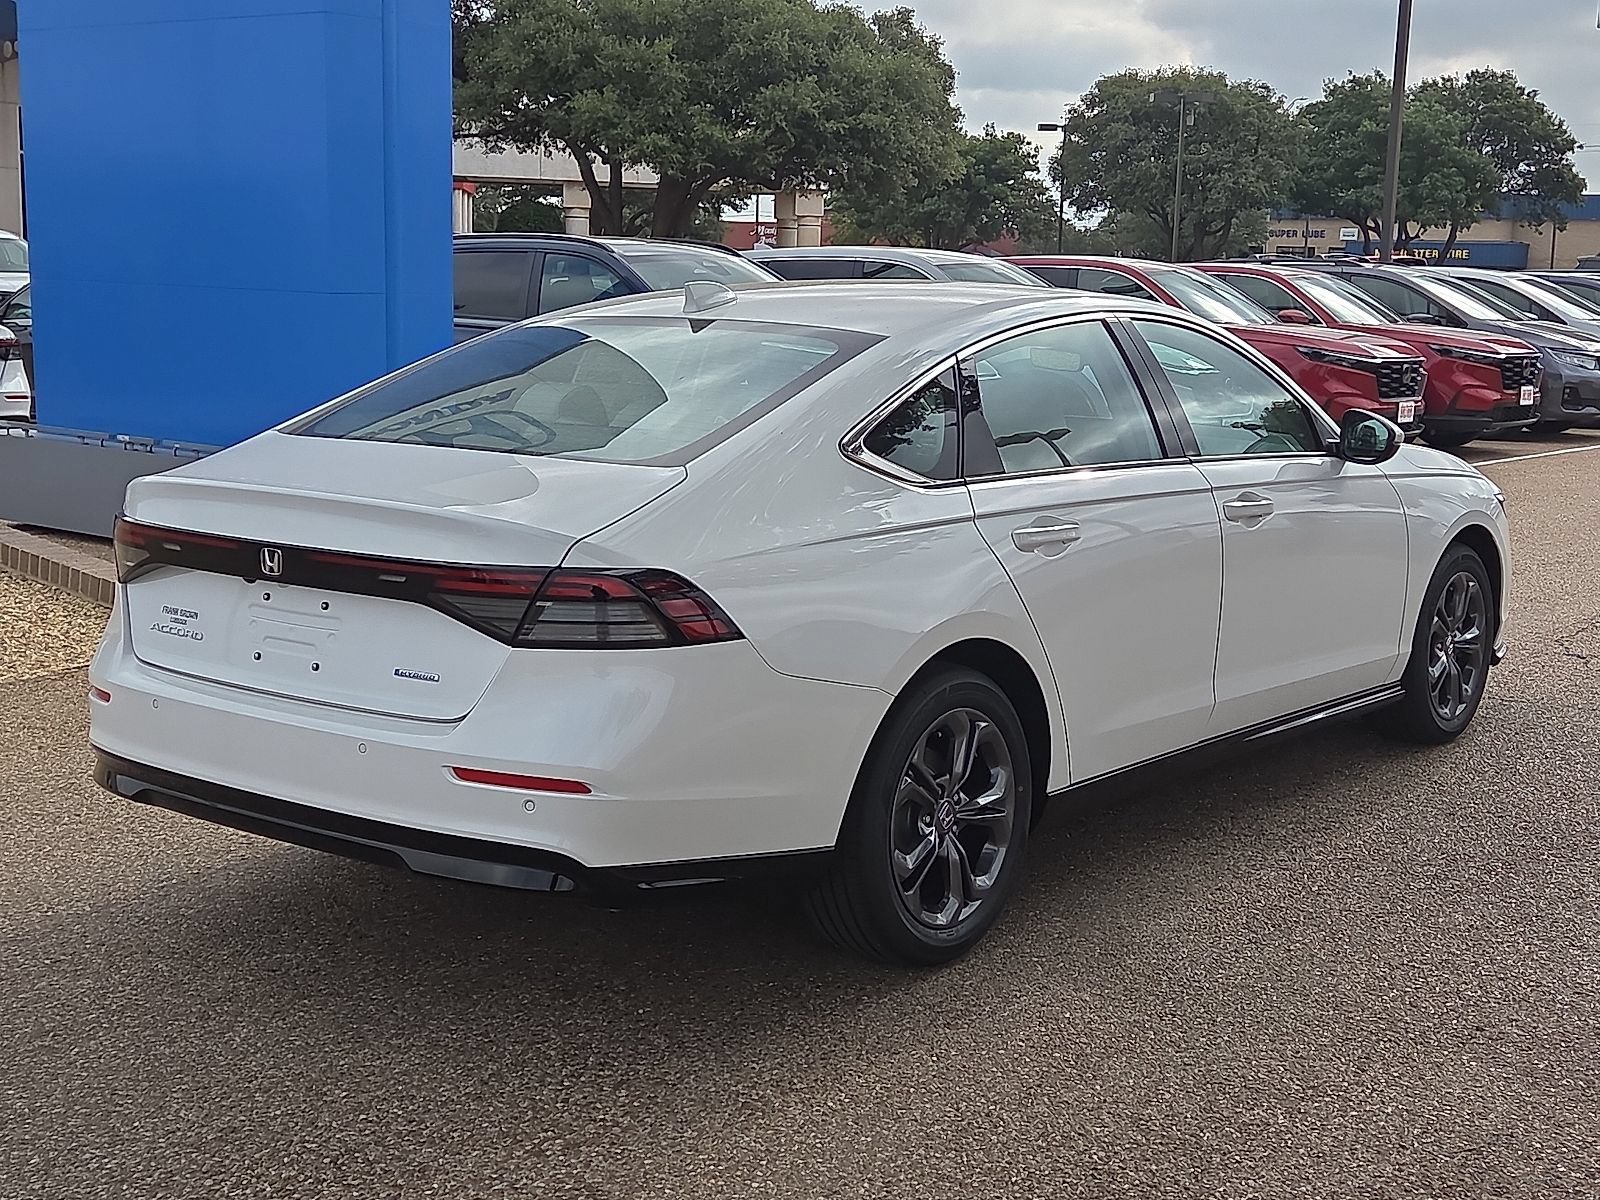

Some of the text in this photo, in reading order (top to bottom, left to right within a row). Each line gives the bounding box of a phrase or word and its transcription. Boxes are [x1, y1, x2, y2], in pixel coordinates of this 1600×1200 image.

[1269, 229, 1326, 239] SUPER LUBE
[150, 620, 203, 641] ACCORD
